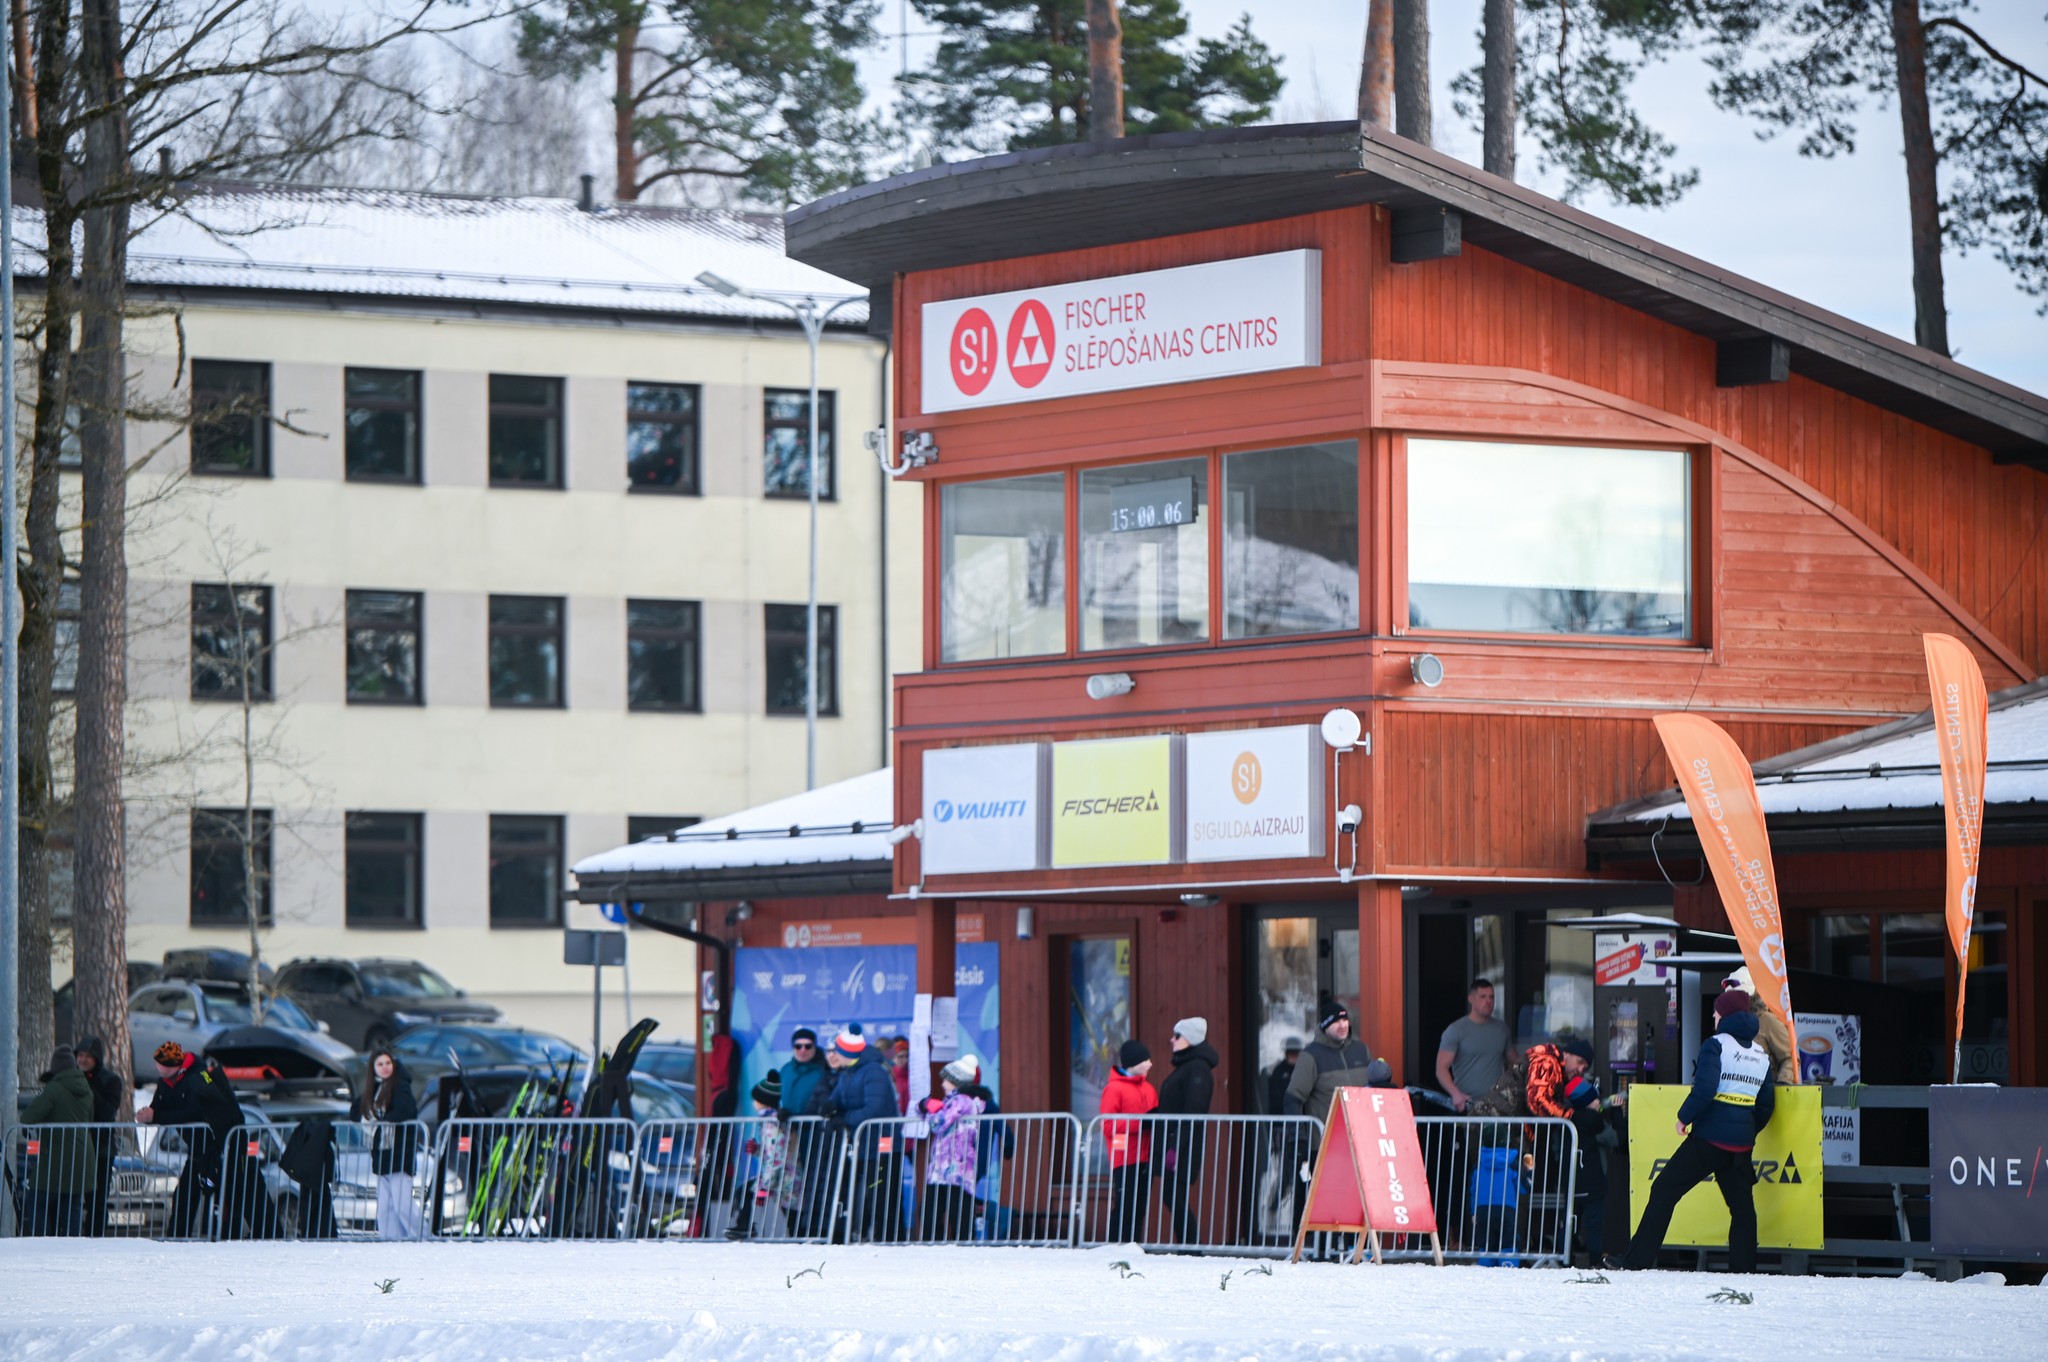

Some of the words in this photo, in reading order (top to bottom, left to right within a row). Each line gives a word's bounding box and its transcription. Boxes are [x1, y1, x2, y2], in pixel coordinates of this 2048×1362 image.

[1065, 292, 1147, 331] FISCHER
[959, 326, 989, 377] S!
[1064, 328, 1194, 373] SLĒPOŠANAS
[1200, 316, 1278, 355] CENTRS
[957, 799, 1027, 820] VAUHTI
[1061, 796, 1146, 817] FISCHER
